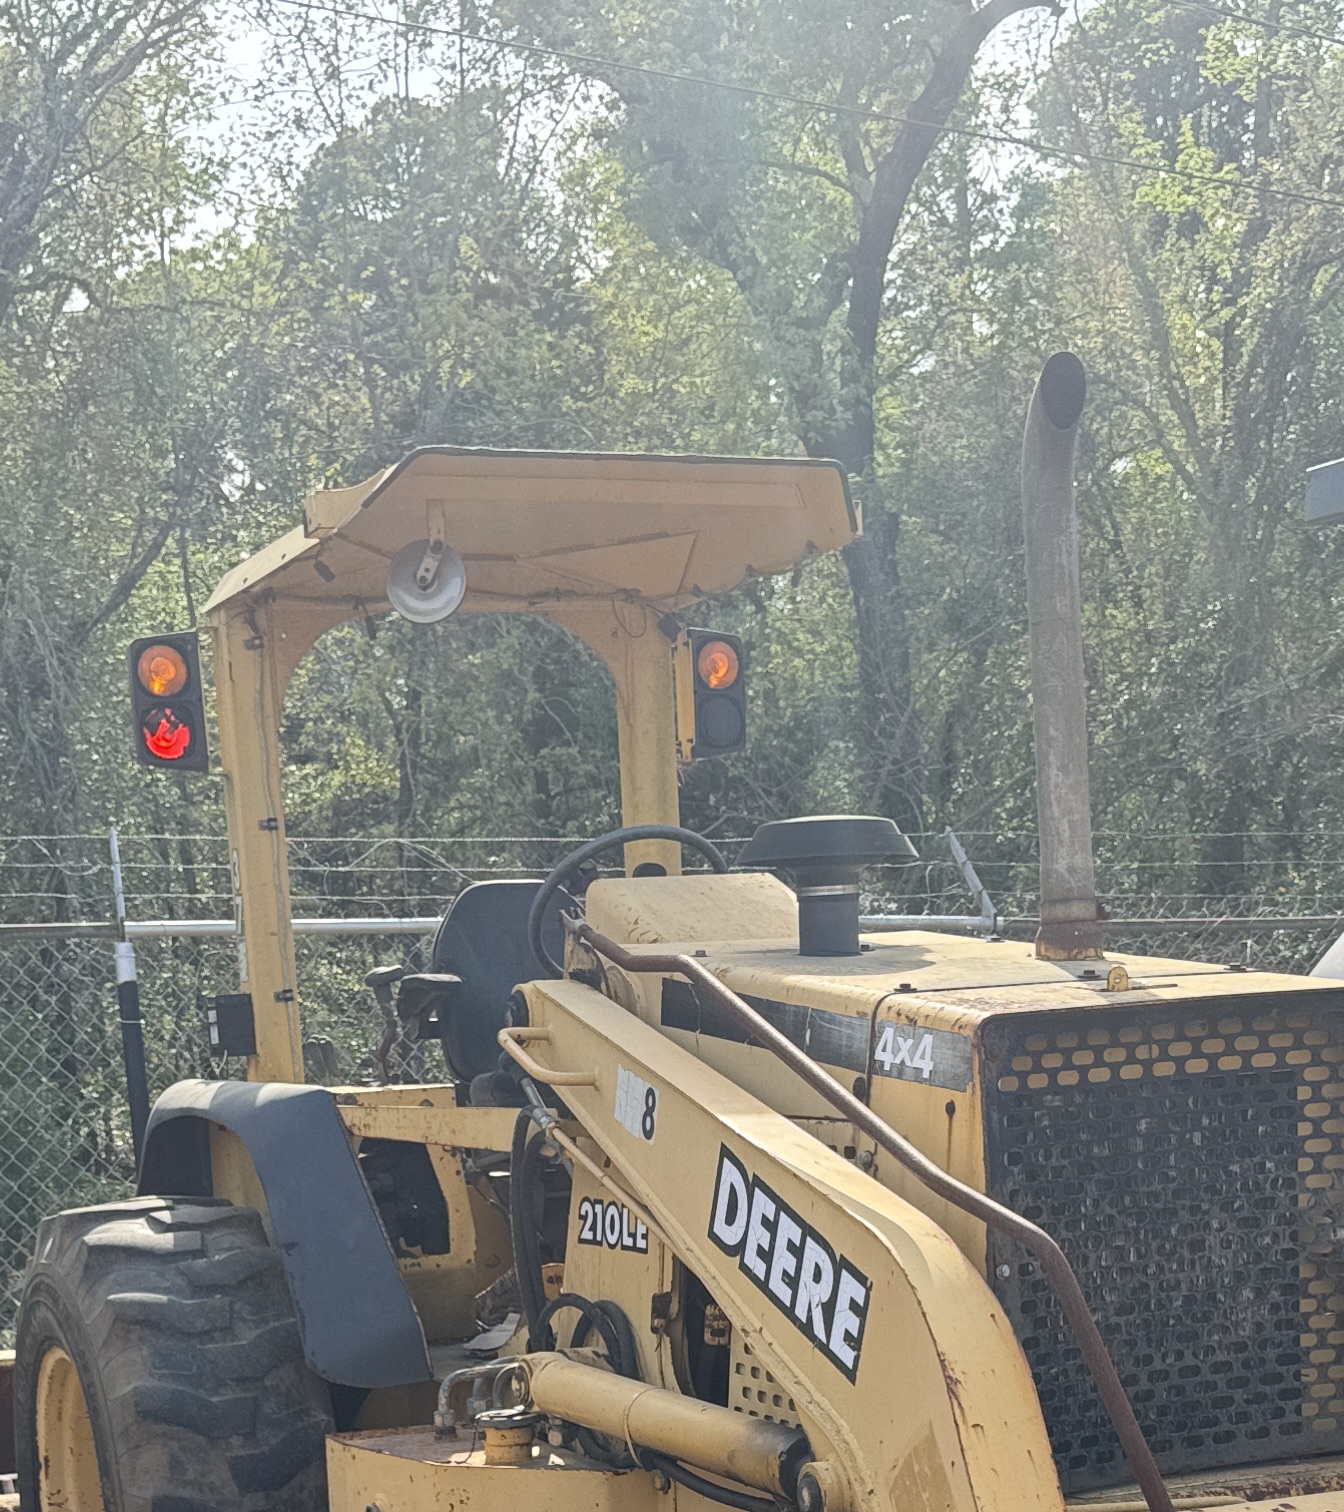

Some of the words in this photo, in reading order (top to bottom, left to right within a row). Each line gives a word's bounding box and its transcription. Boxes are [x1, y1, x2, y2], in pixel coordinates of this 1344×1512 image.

[874, 1026, 934, 1079] 4x4
[641, 1086, 657, 1141] 8
[578, 1197, 648, 1254] 210LE
[709, 1144, 871, 1384] DEERE
